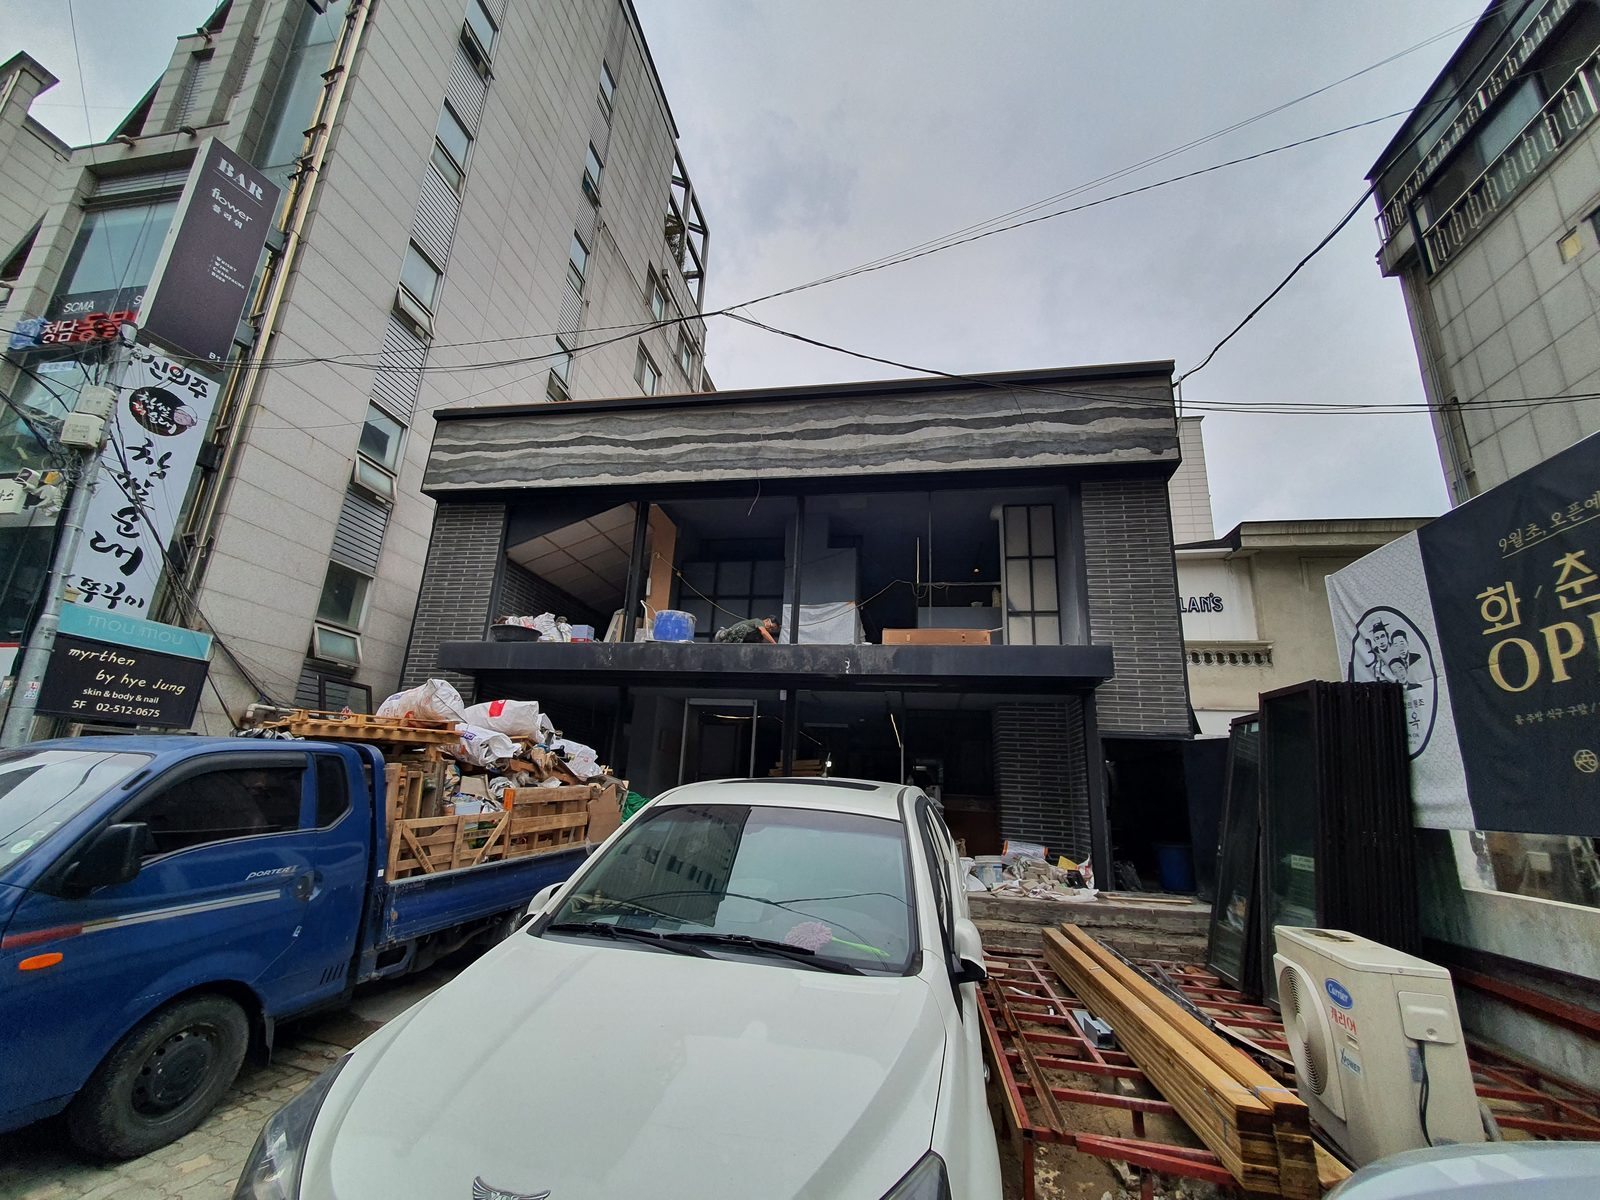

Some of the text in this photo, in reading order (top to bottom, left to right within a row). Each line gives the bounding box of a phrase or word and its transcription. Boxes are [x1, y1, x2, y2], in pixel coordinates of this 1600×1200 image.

[217, 157, 264, 201] BAR
[63, 301, 94, 313] SCMA
[208, 351, 222, 363] B1
[141, 354, 209, 399] 신의주
[68, 648, 136, 667] myrthen
[95, 669, 186, 696] by hye jung
[82, 687, 160, 704] skin & body & nail
[71, 700, 161, 718] 5F 02-512-0675
[1327, 984, 1349, 1003] Carrier
[1330, 1007, 1357, 1035] 캐리어
